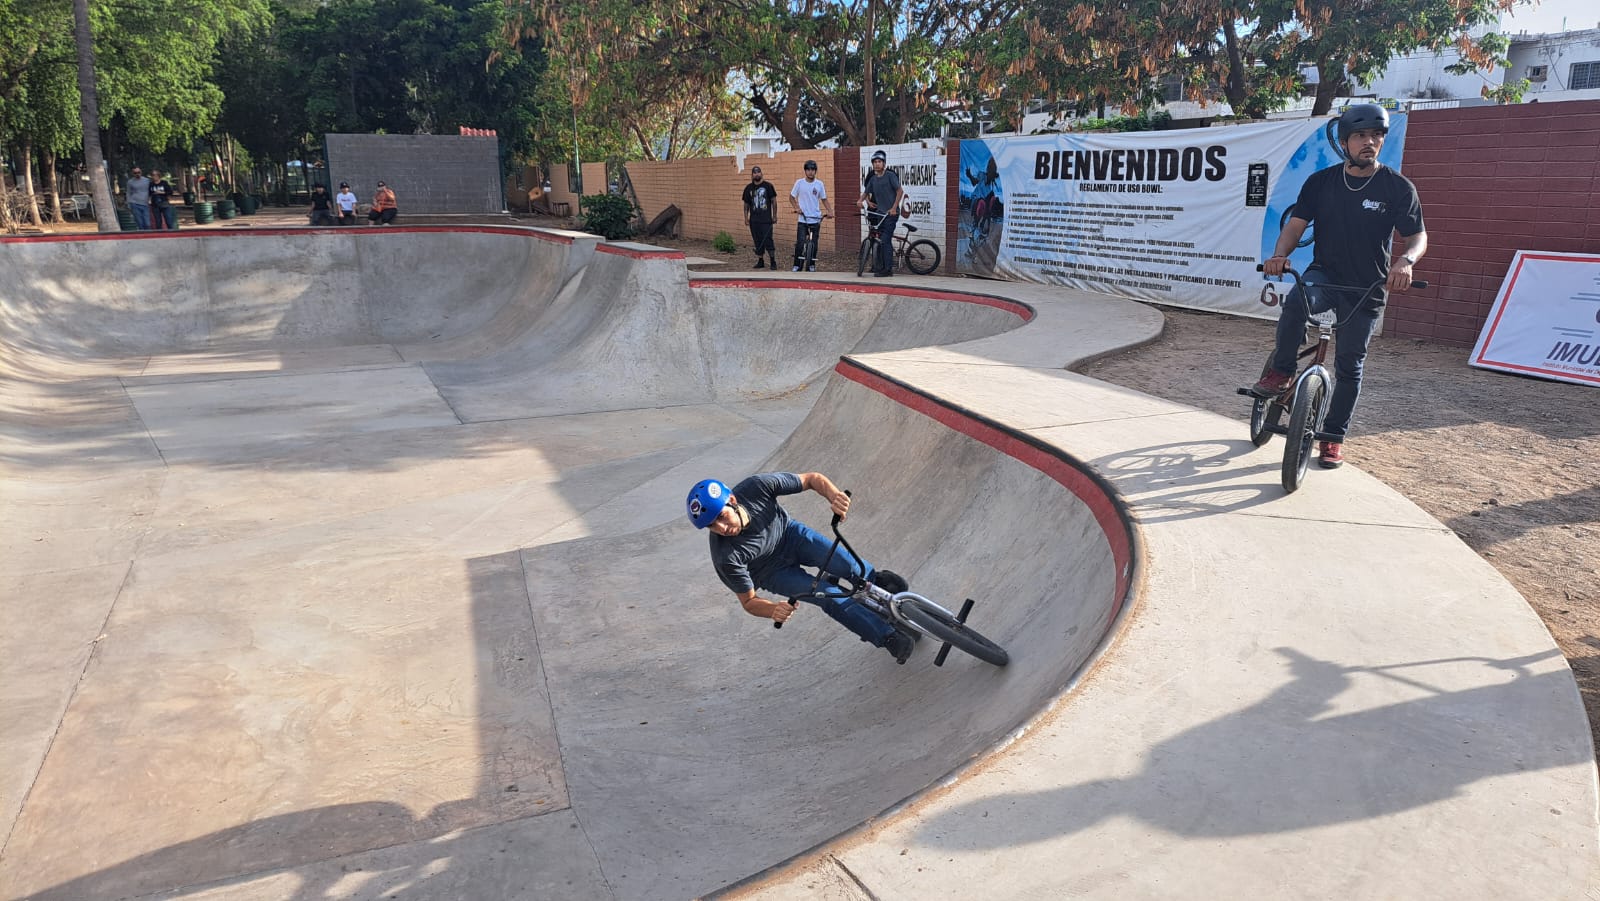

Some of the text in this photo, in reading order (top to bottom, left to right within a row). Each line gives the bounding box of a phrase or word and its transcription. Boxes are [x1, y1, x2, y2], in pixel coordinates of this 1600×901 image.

[1034, 145, 1227, 182] BIENVENIDOS
[910, 164, 937, 187] GUASAVE
[1079, 183, 1163, 194] REGLAMENTO DE USO BOWL:
[1108, 266, 1114, 274] DE
[1114, 267, 1124, 275] LAS
[1124, 268, 1162, 280] INSTALACIONES
[1168, 273, 1206, 284] PRACTICANDO
[1207, 277, 1214, 285] EL
[1214, 278, 1242, 288] DEPORTE
